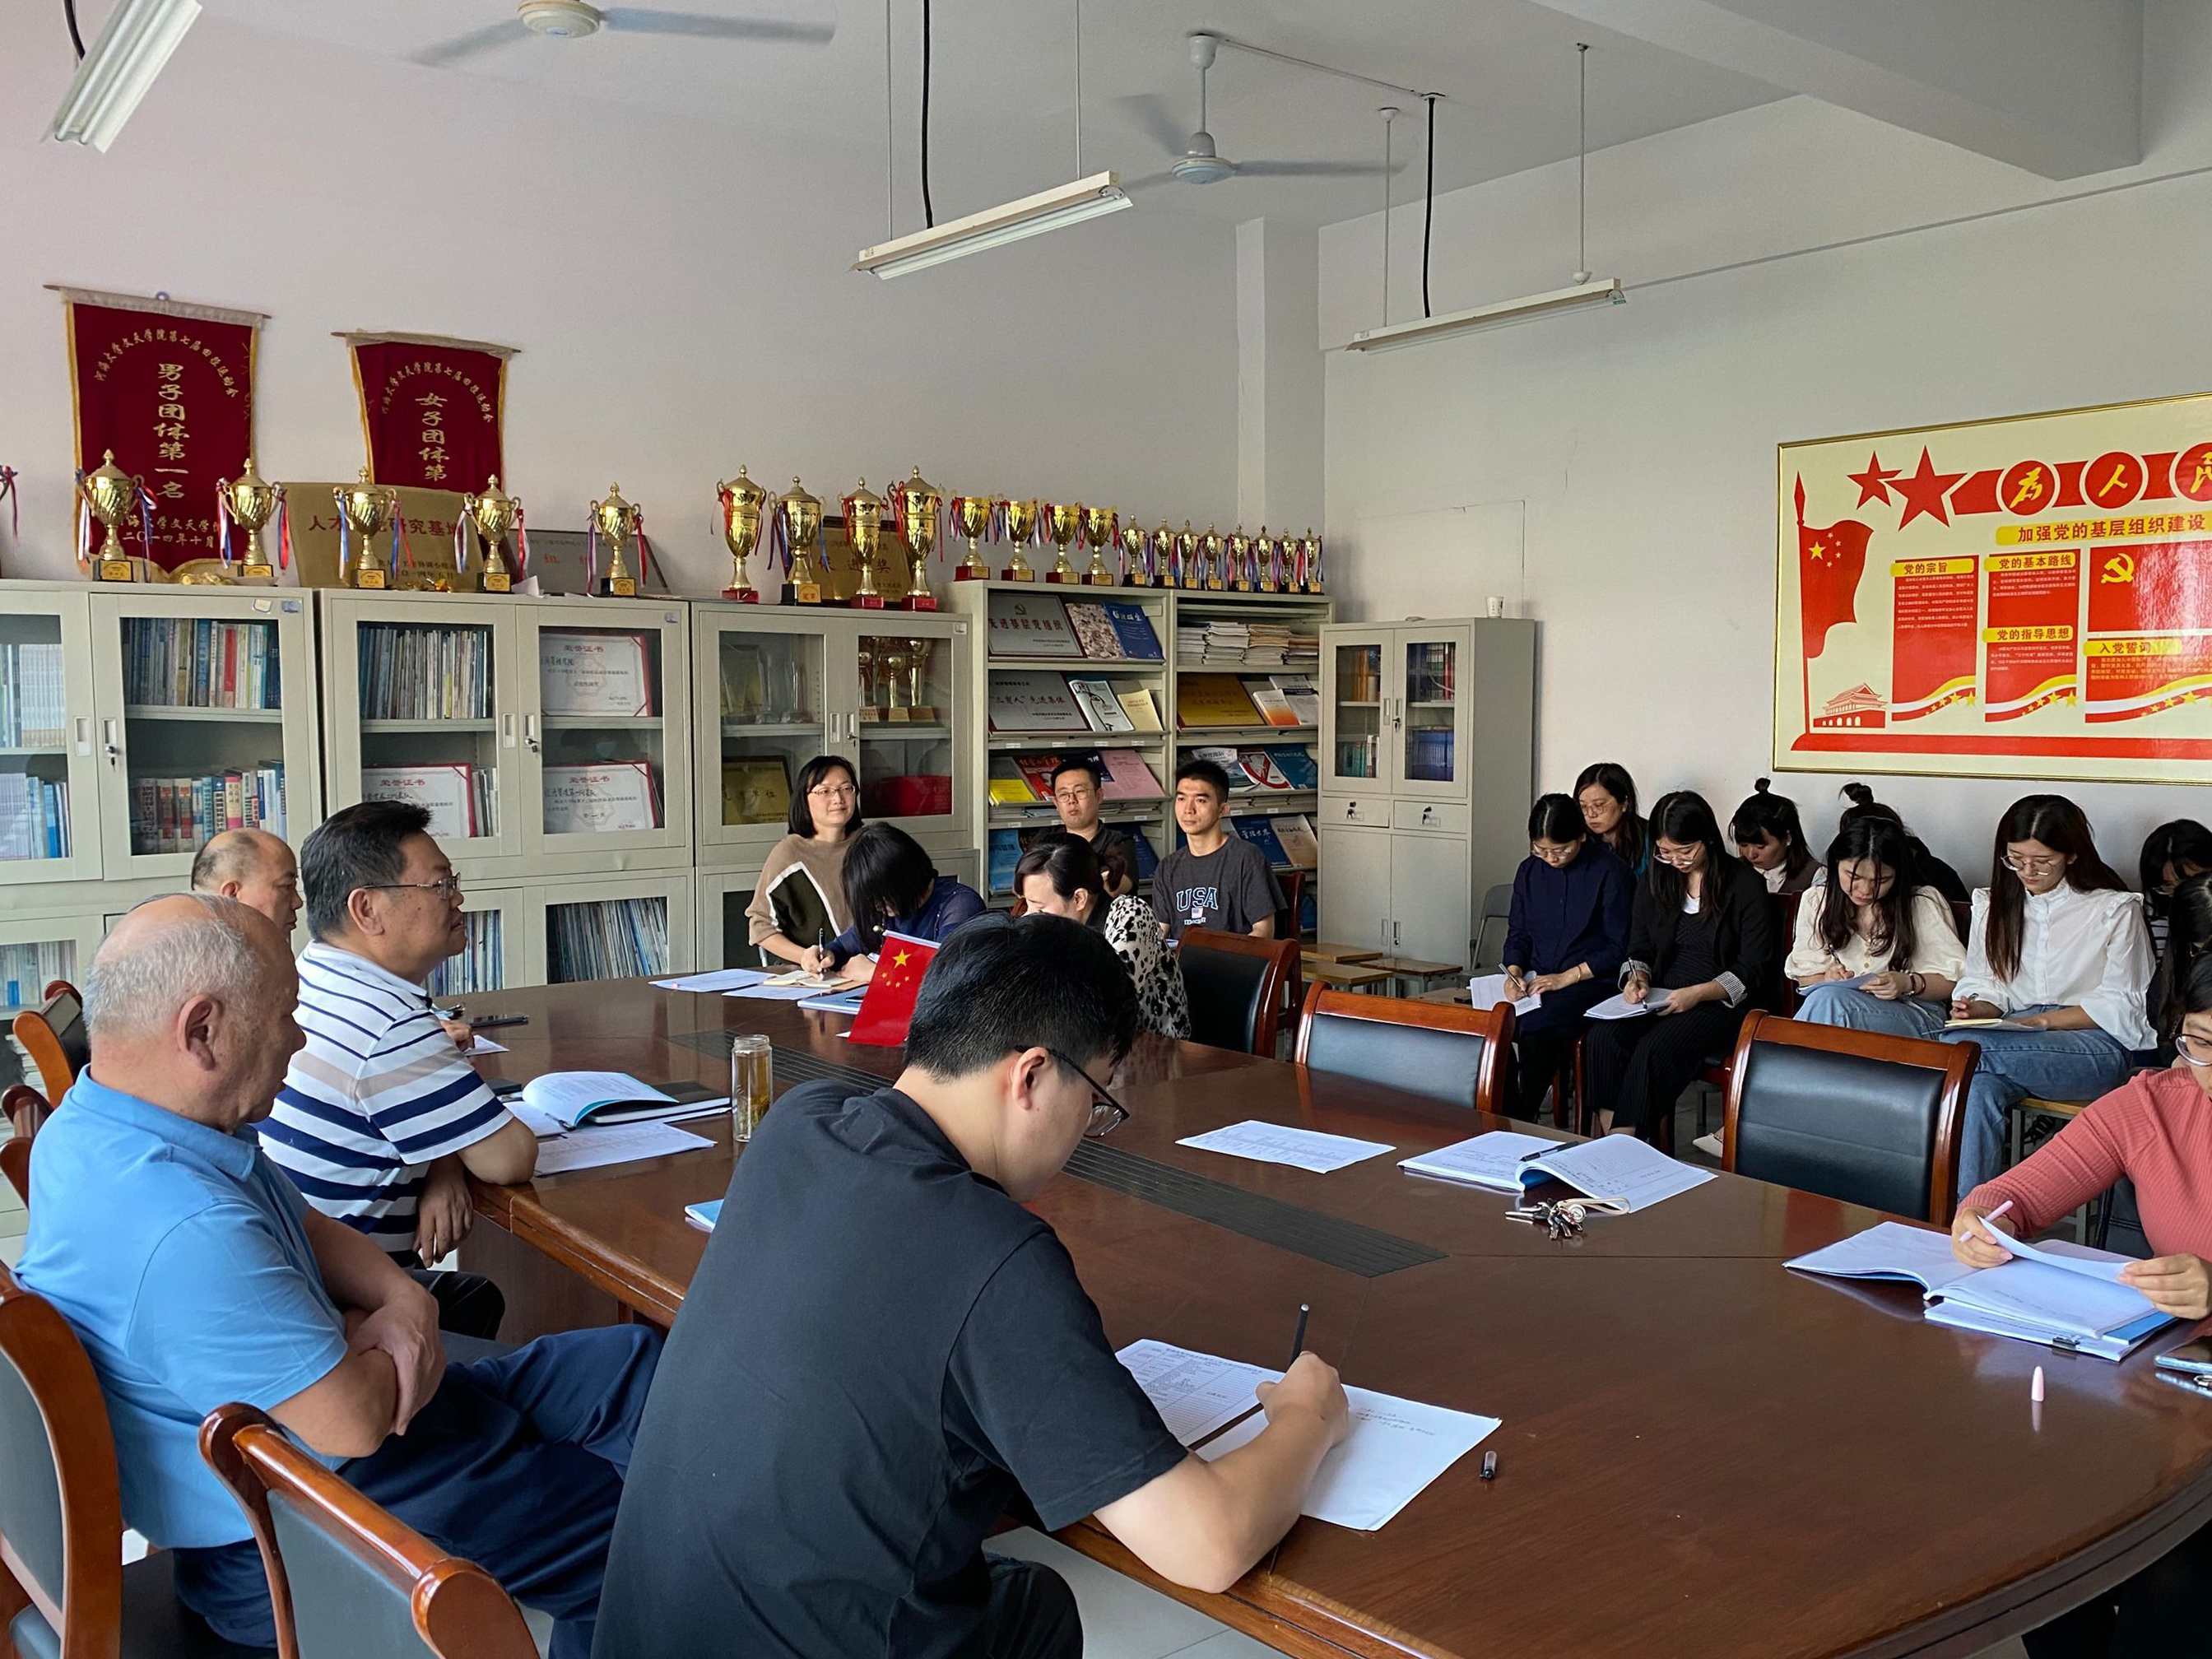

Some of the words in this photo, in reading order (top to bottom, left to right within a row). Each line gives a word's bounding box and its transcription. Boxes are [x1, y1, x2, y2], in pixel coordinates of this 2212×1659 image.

[153, 363, 190, 500] 男子团体第一名
[415, 393, 450, 482] 女子团体第
[2018, 514, 2206, 543] 加强党的基层组织建设
[1903, 562, 1948, 574] 党的宗旨
[1998, 554, 2072, 569] 党的基本路线
[1996, 627, 2070, 641] 党的指导思想
[2099, 642, 2151, 654] 入党誓词
[1176, 886, 1219, 912] USA
